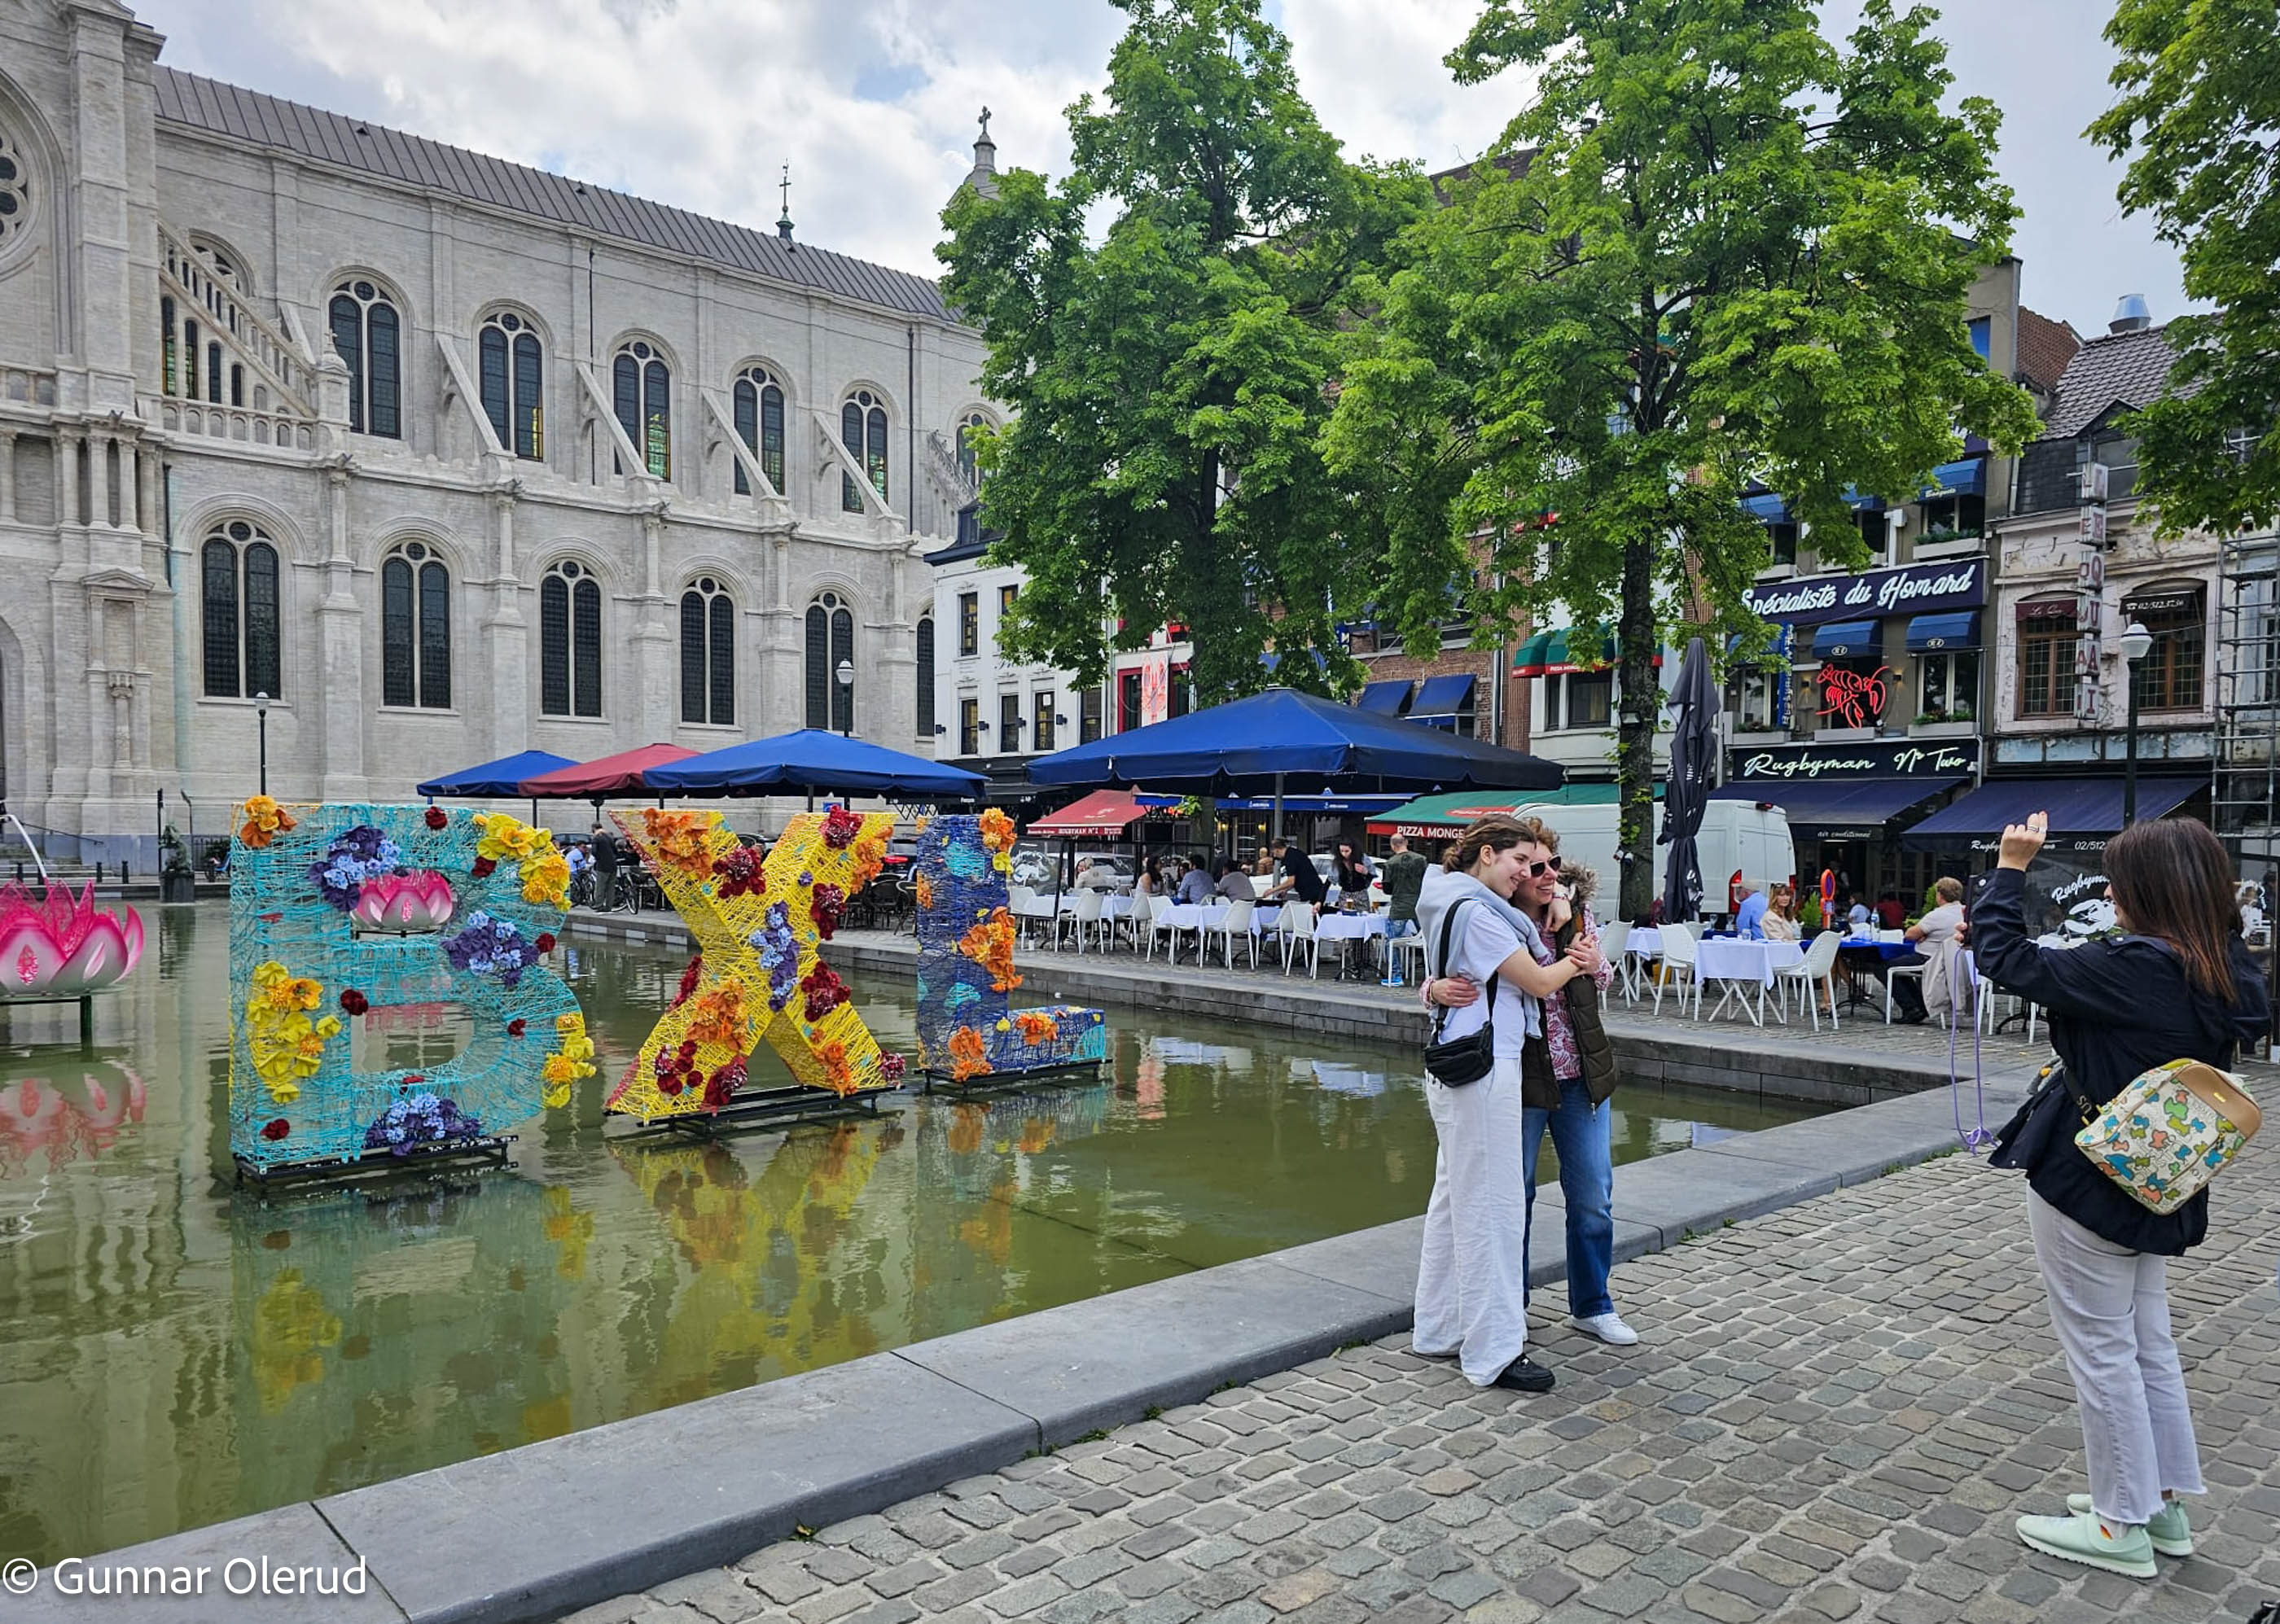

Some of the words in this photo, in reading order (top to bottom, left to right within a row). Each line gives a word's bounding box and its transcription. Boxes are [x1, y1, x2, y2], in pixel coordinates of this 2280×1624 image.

[1741, 584, 1836, 616] Spécialiste
[1844, 578, 1872, 606] du
[1876, 563, 1976, 611] Homard
[1743, 752, 1876, 777] Rugbyman
[1927, 746, 1966, 772] Two
[1396, 825, 1425, 837] PIZZA
